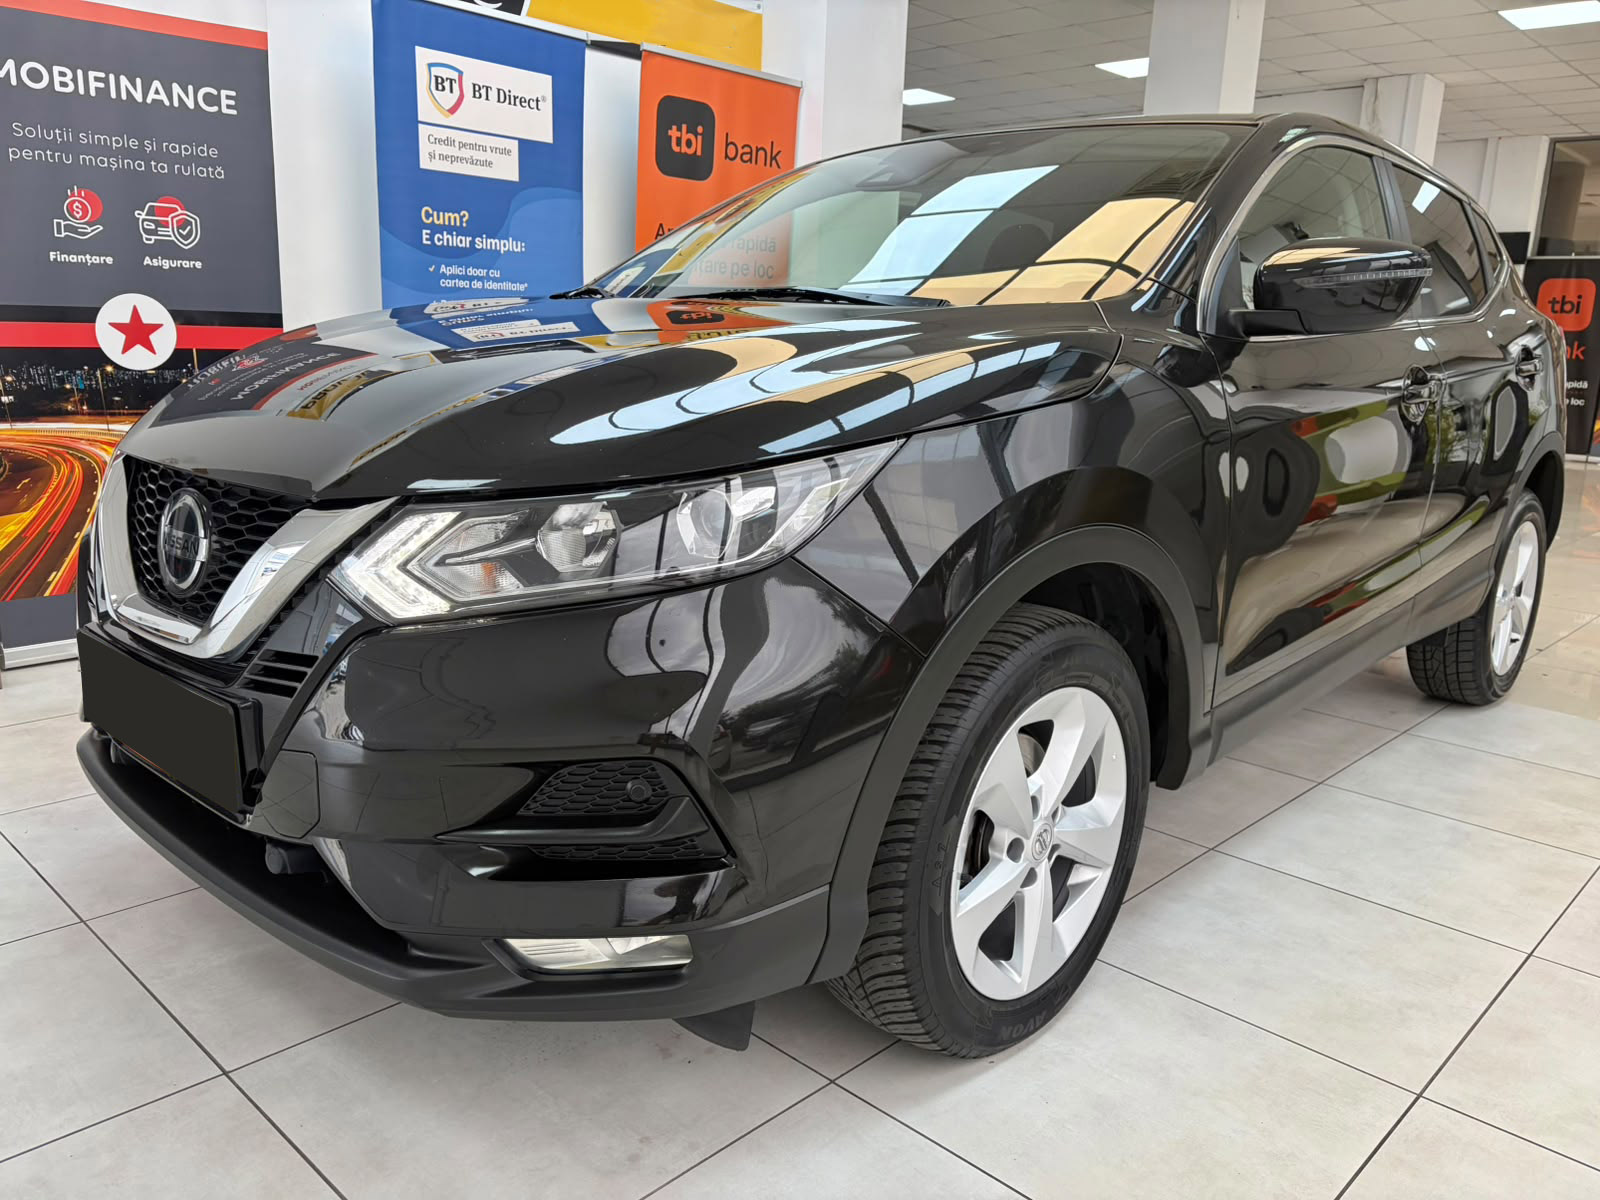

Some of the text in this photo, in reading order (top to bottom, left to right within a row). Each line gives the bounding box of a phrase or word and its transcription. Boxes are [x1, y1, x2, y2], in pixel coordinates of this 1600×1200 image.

[434, 75, 457, 94] BT
[472, 83, 492, 100] BT
[79, 130, 139, 150] simple
[162, 141, 219, 158] rapide
[427, 134, 512, 156] Credit pentru vrute
[668, 124, 782, 169] tbi bank
[8, 145, 72, 164] pentru
[150, 159, 168, 174] ta
[421, 206, 469, 227] Cum?
[422, 229, 526, 254] E chiar simplu:
[143, 256, 202, 269] Asigurare
[439, 264, 500, 278] Aplici doar cu
[731, 262, 750, 280] pe
[754, 260, 775, 280] loc
[440, 278, 469, 289] cartea
[472, 279, 483, 289] de
[1548, 295, 1583, 315] tbi
